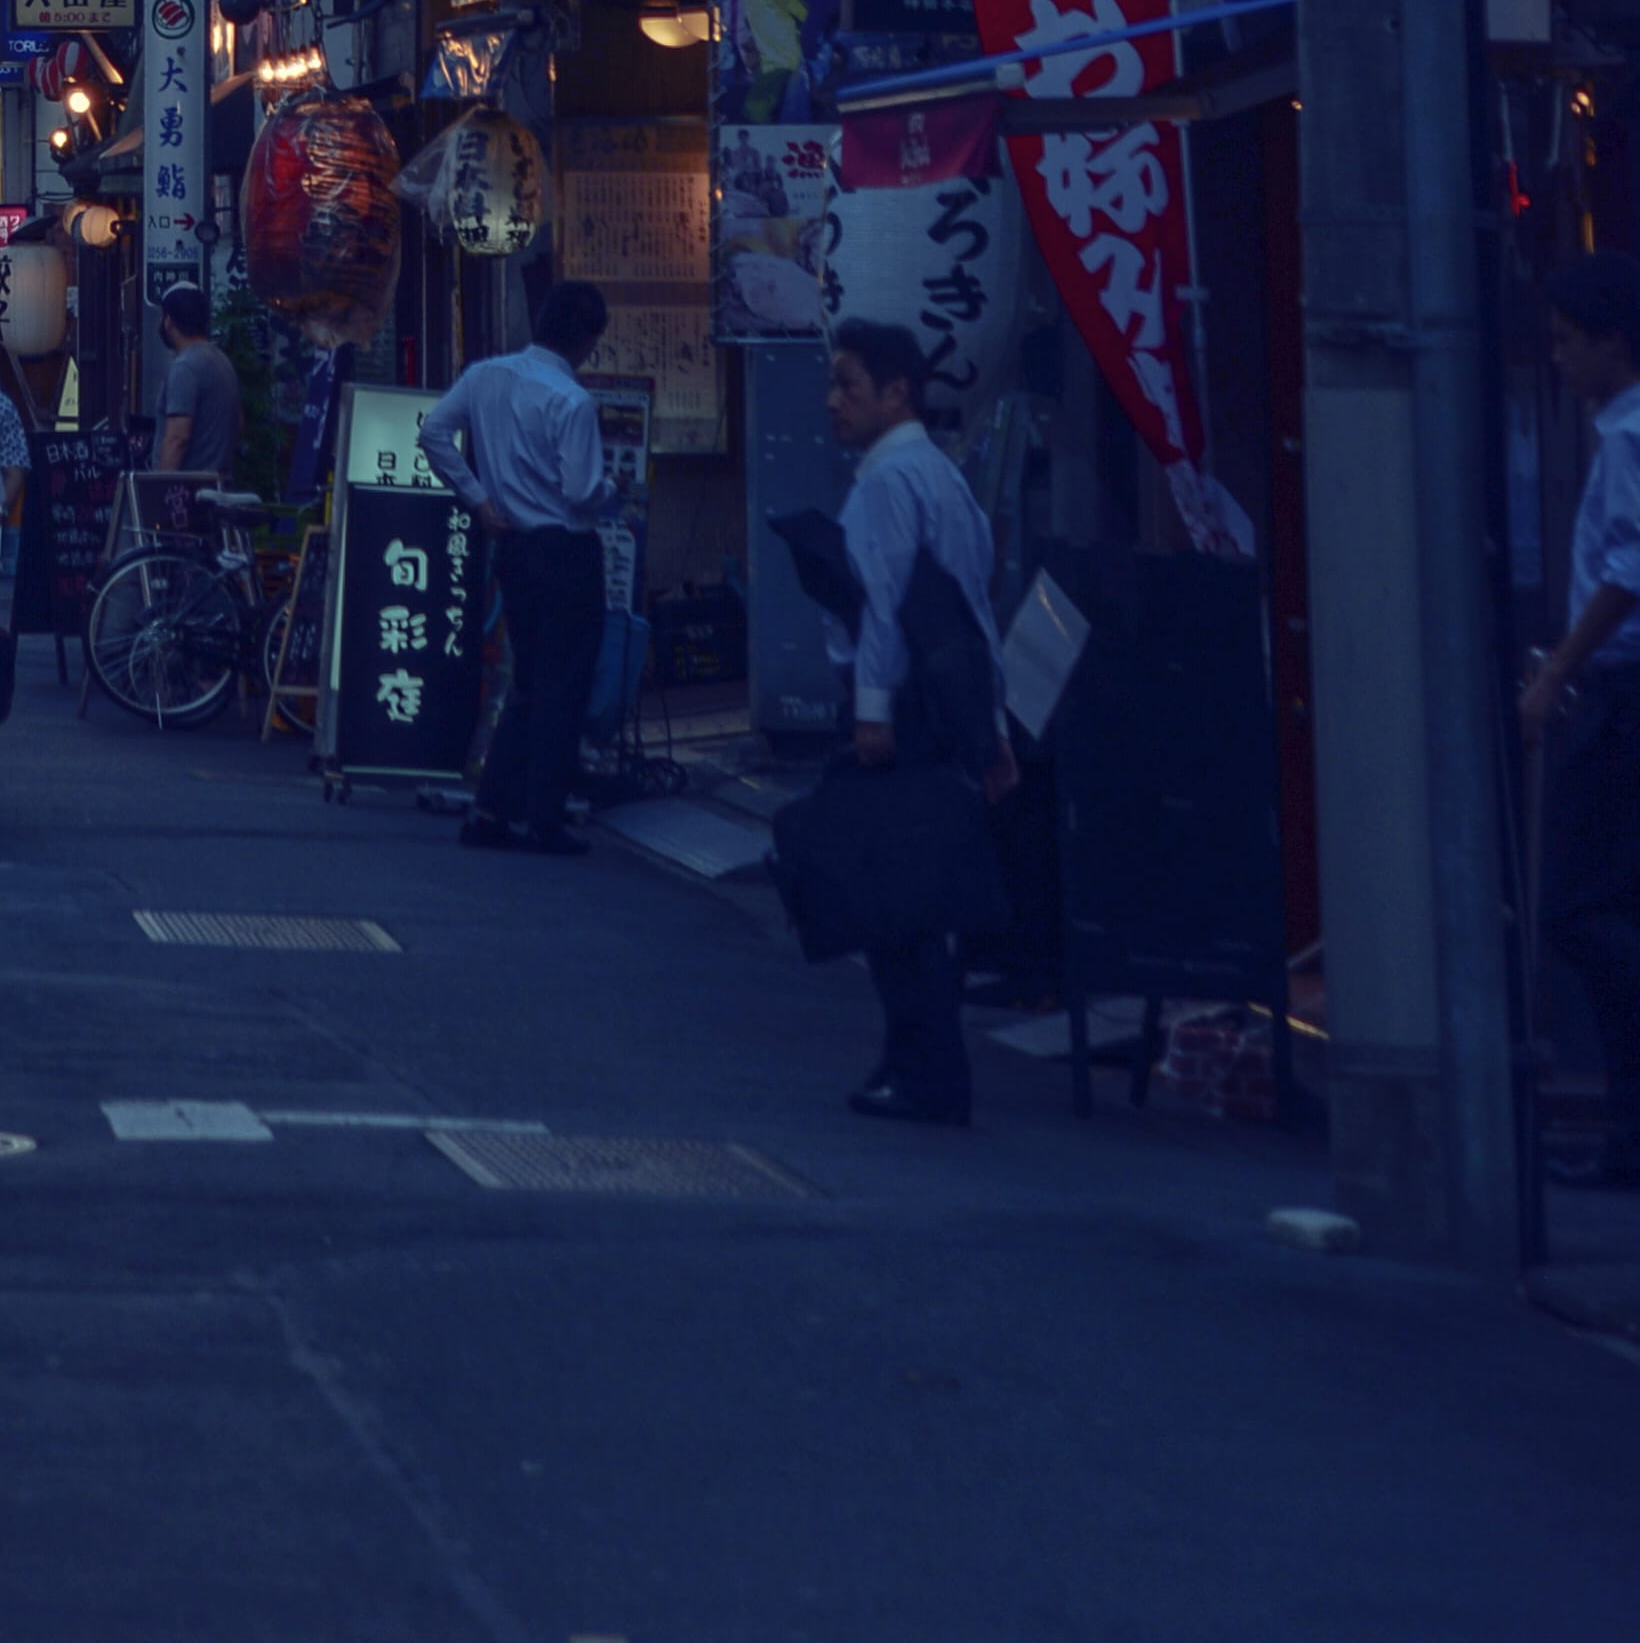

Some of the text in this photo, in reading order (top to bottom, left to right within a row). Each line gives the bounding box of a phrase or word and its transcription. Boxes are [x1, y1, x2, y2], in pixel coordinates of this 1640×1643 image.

[156, 56, 188, 200] 大勇鮨
[922, 173, 990, 389] ろきん
